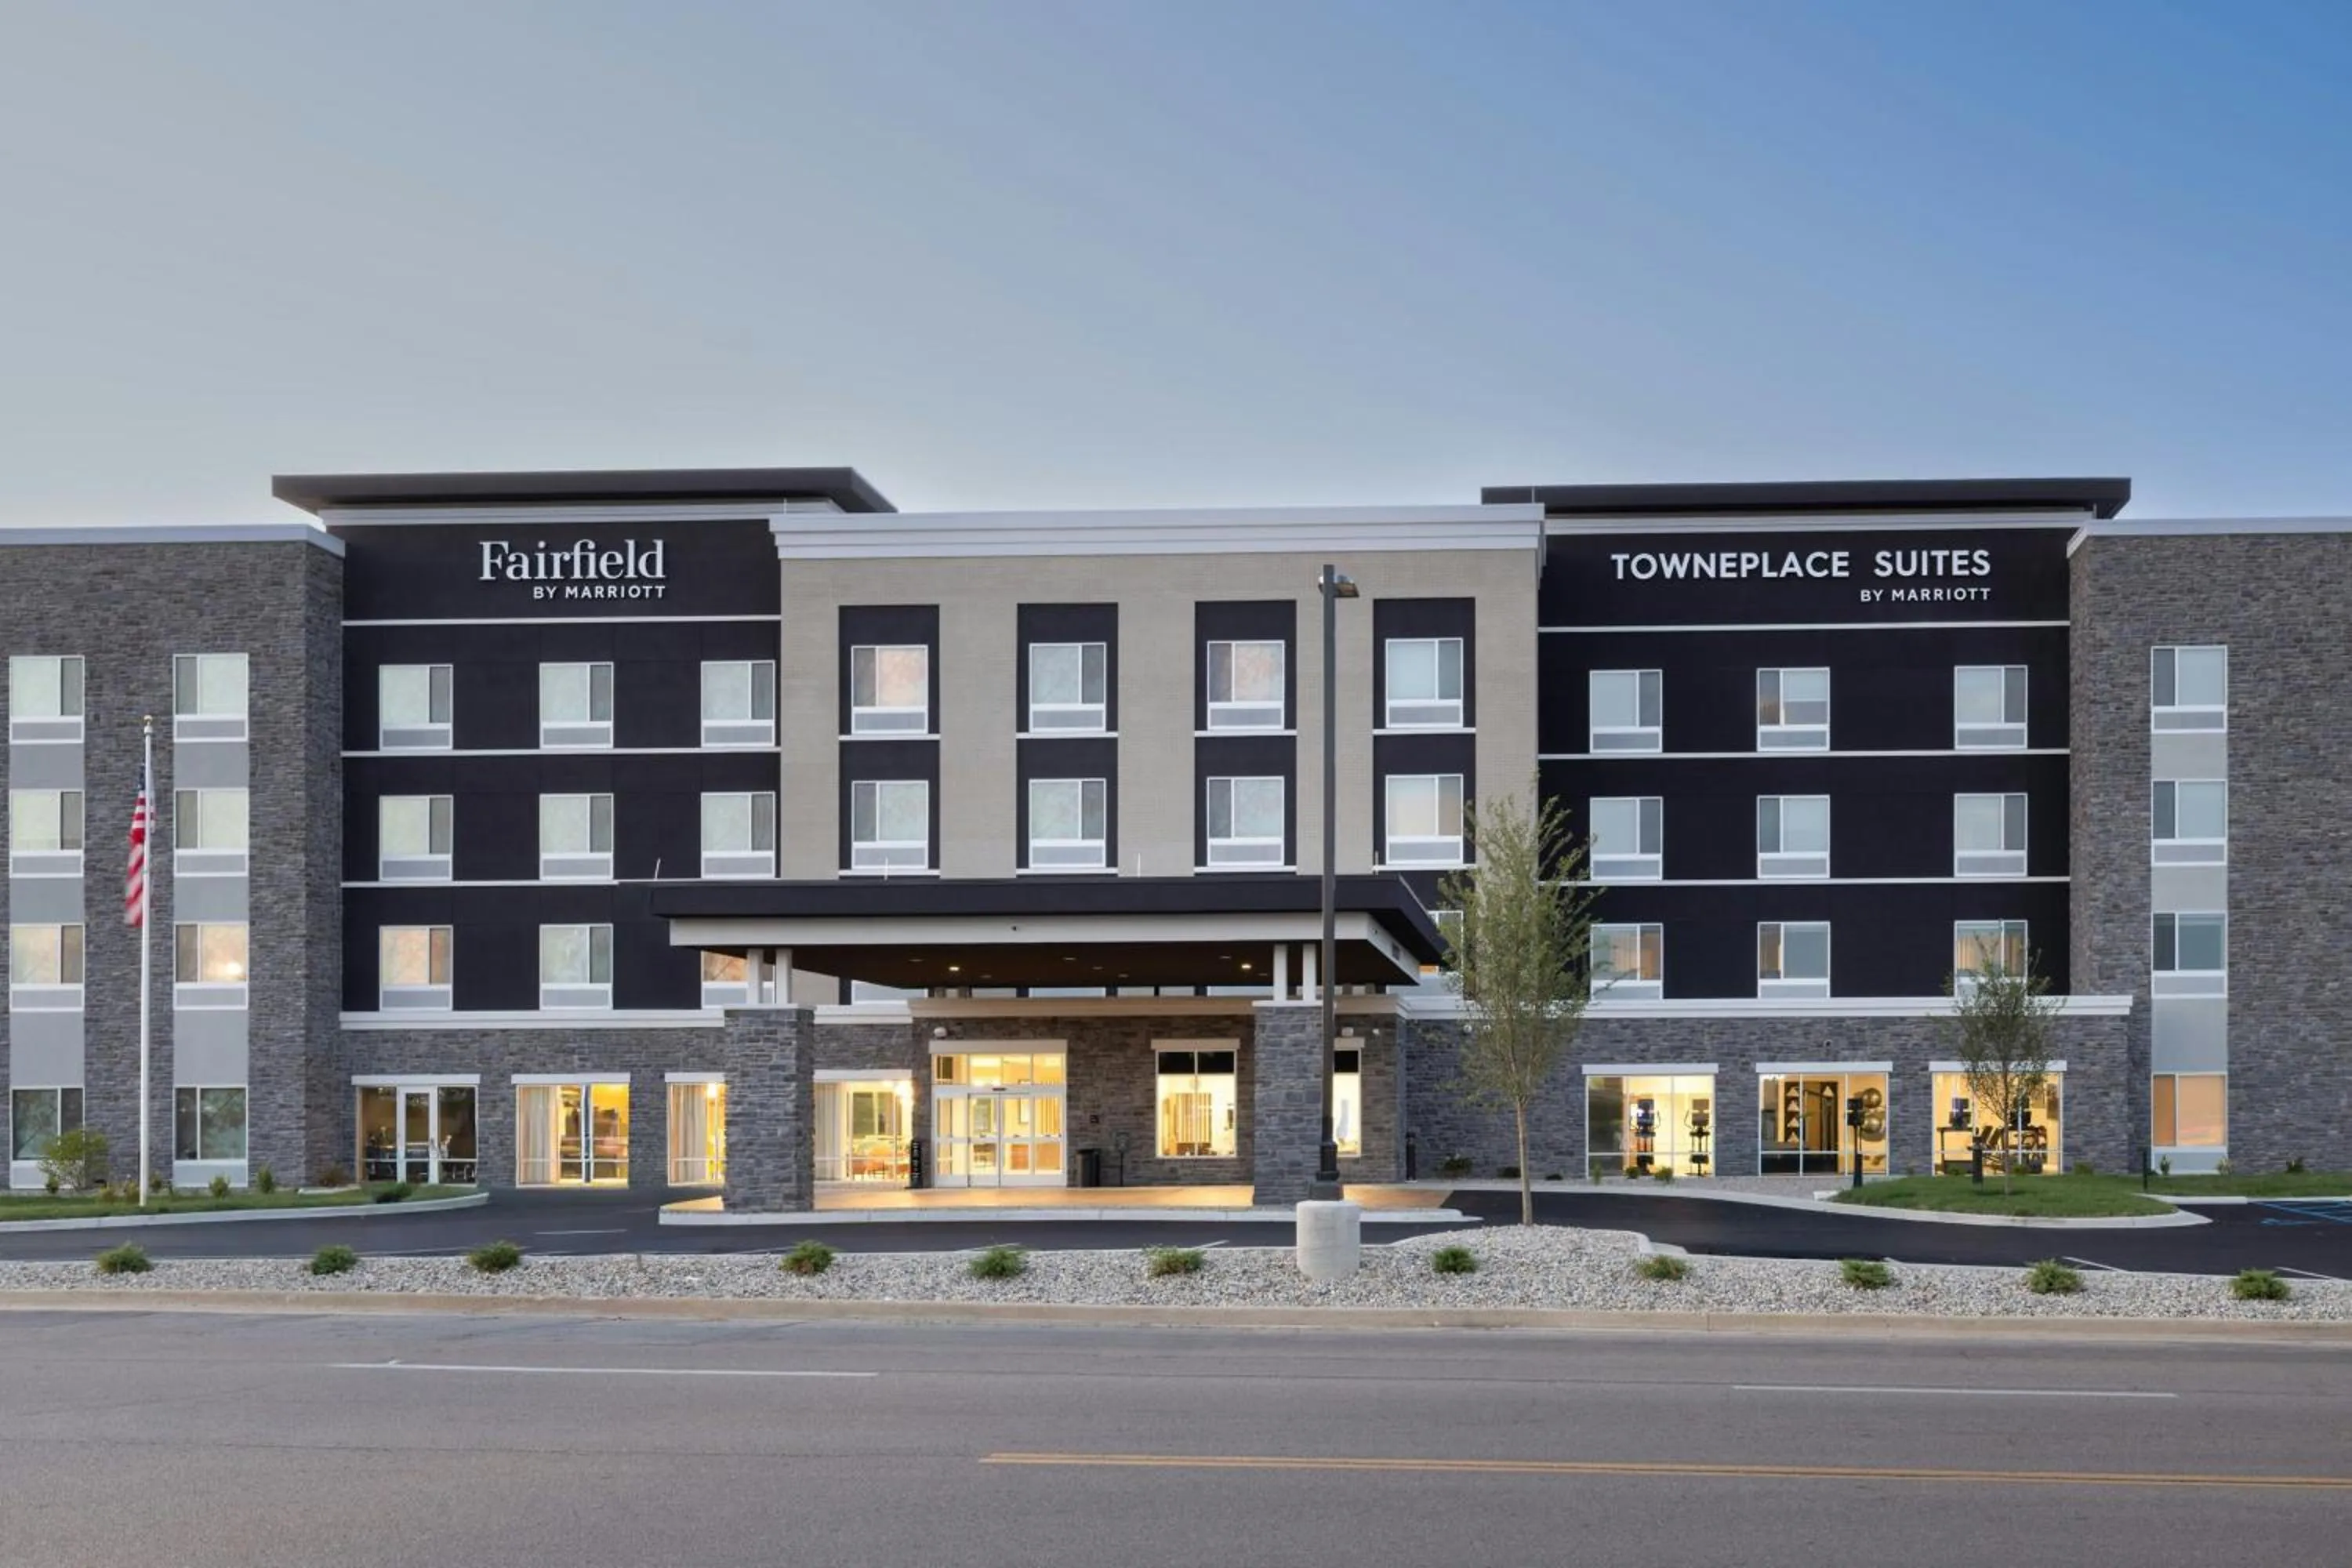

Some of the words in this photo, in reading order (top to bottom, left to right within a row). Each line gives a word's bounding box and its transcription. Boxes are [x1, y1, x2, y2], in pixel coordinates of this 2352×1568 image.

[478, 539, 666, 580] Fairfield
[1610, 552, 1849, 579] TOWNEPLACE
[1874, 549, 1991, 577] SUITES
[533, 586, 556, 599] BY
[564, 586, 666, 599] MARRIOTT
[1860, 589, 1884, 602] BY
[1891, 587, 1991, 601] MARRIOTT
